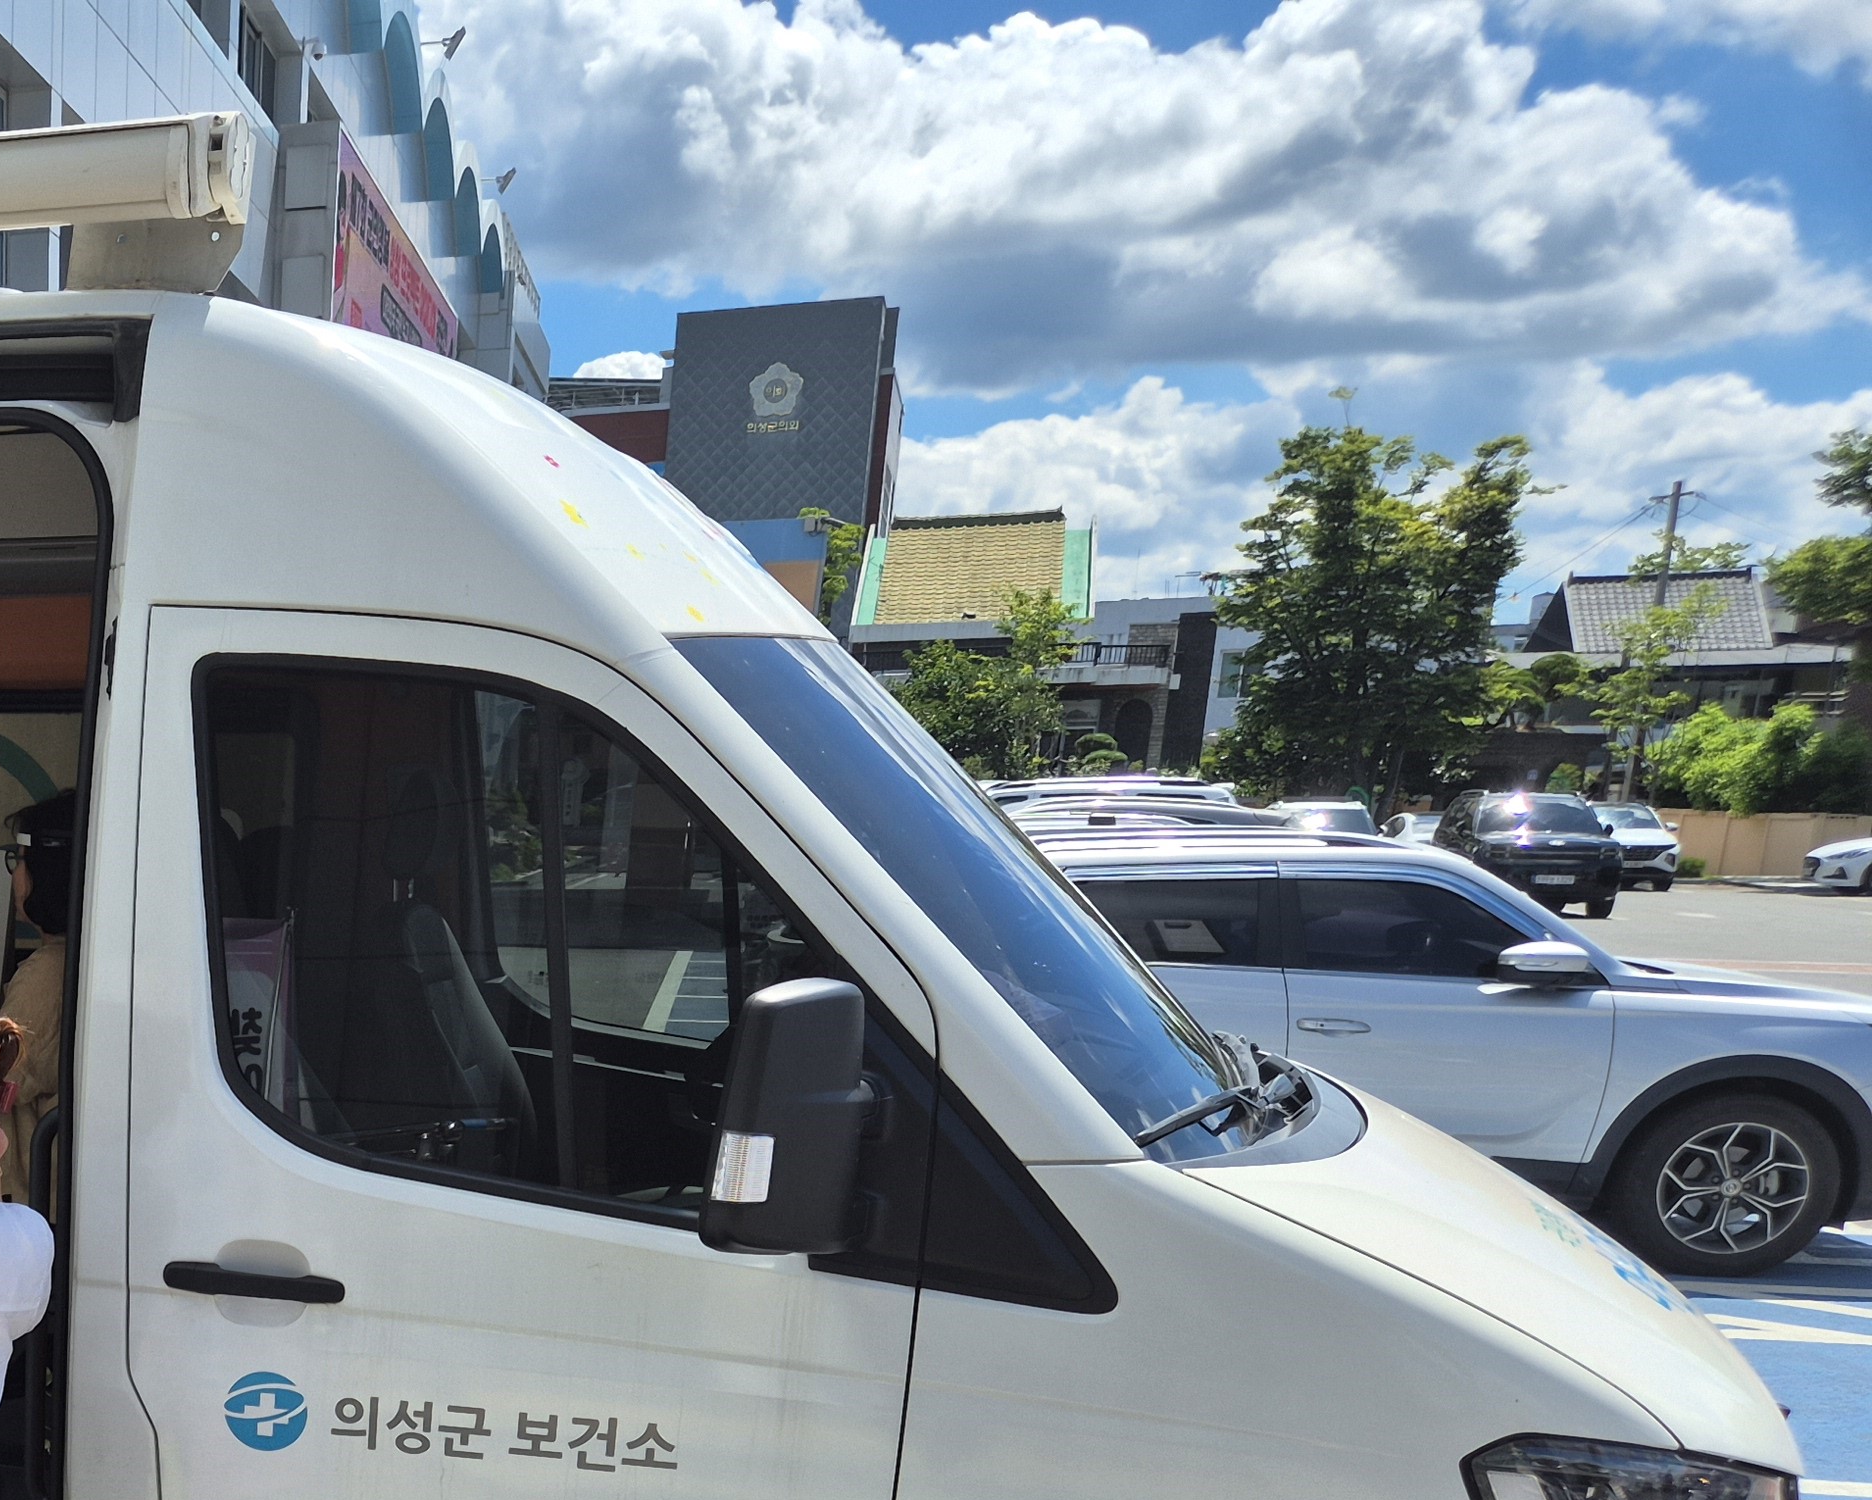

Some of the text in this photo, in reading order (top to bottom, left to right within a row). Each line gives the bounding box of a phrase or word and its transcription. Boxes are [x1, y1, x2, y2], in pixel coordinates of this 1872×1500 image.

[746, 420, 800, 433] 의성군의회
[330, 1396, 679, 1473] 의성군 보건소
